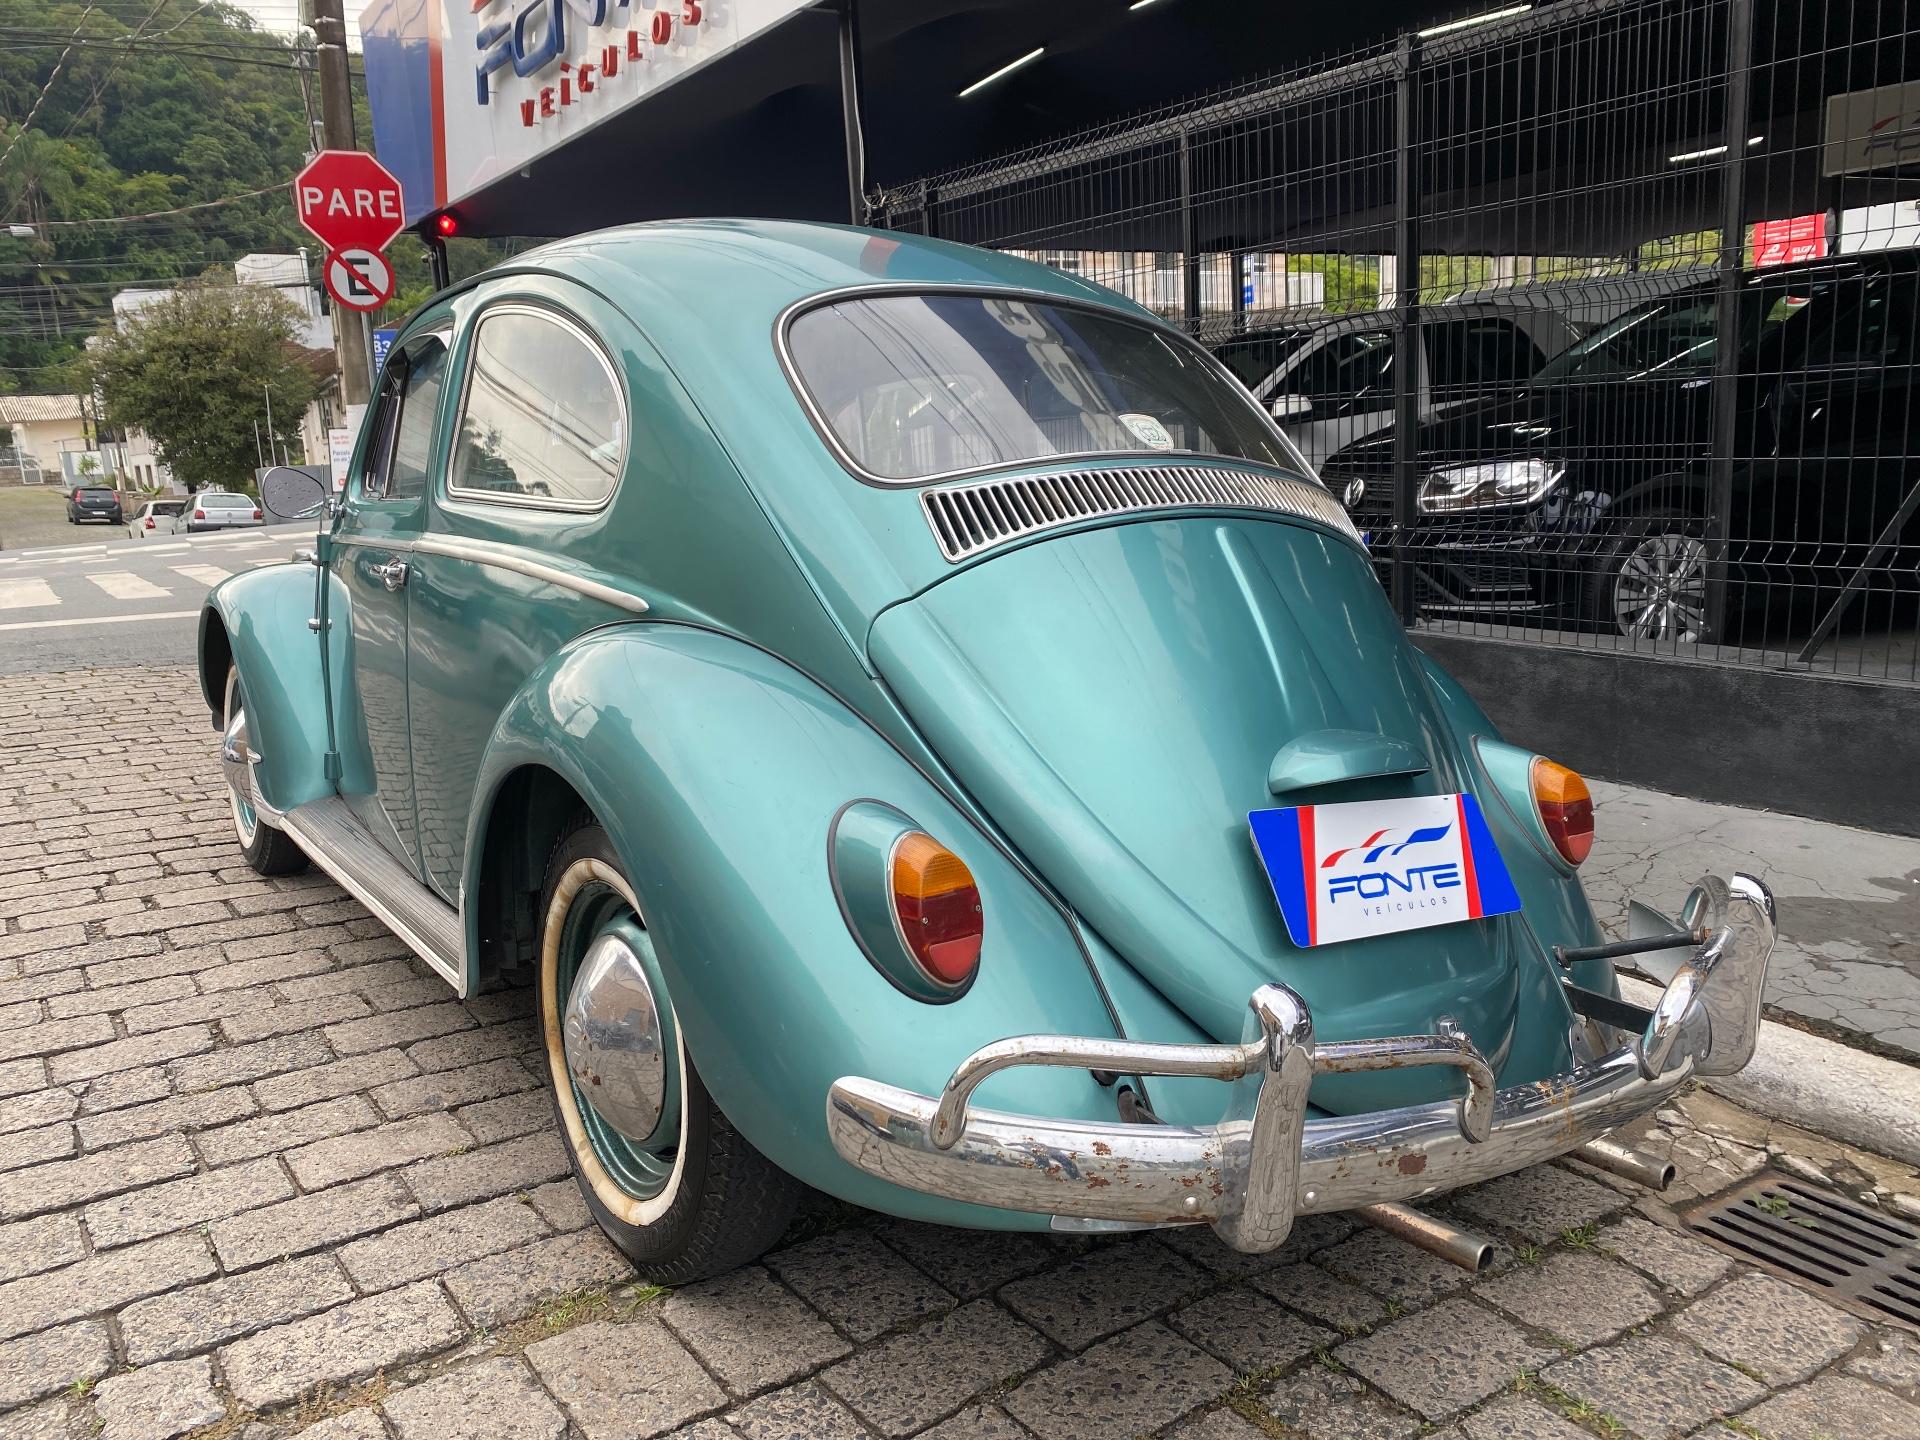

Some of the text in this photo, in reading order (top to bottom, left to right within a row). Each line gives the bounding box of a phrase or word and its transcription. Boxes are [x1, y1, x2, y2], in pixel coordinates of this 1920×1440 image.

[520, 0, 702, 127] VEÍCULOS
[303, 186, 400, 219] PARE
[346, 257, 374, 297] E
[1328, 863, 1462, 904] FONTE
[1363, 896, 1448, 917] VEÍCULOS
